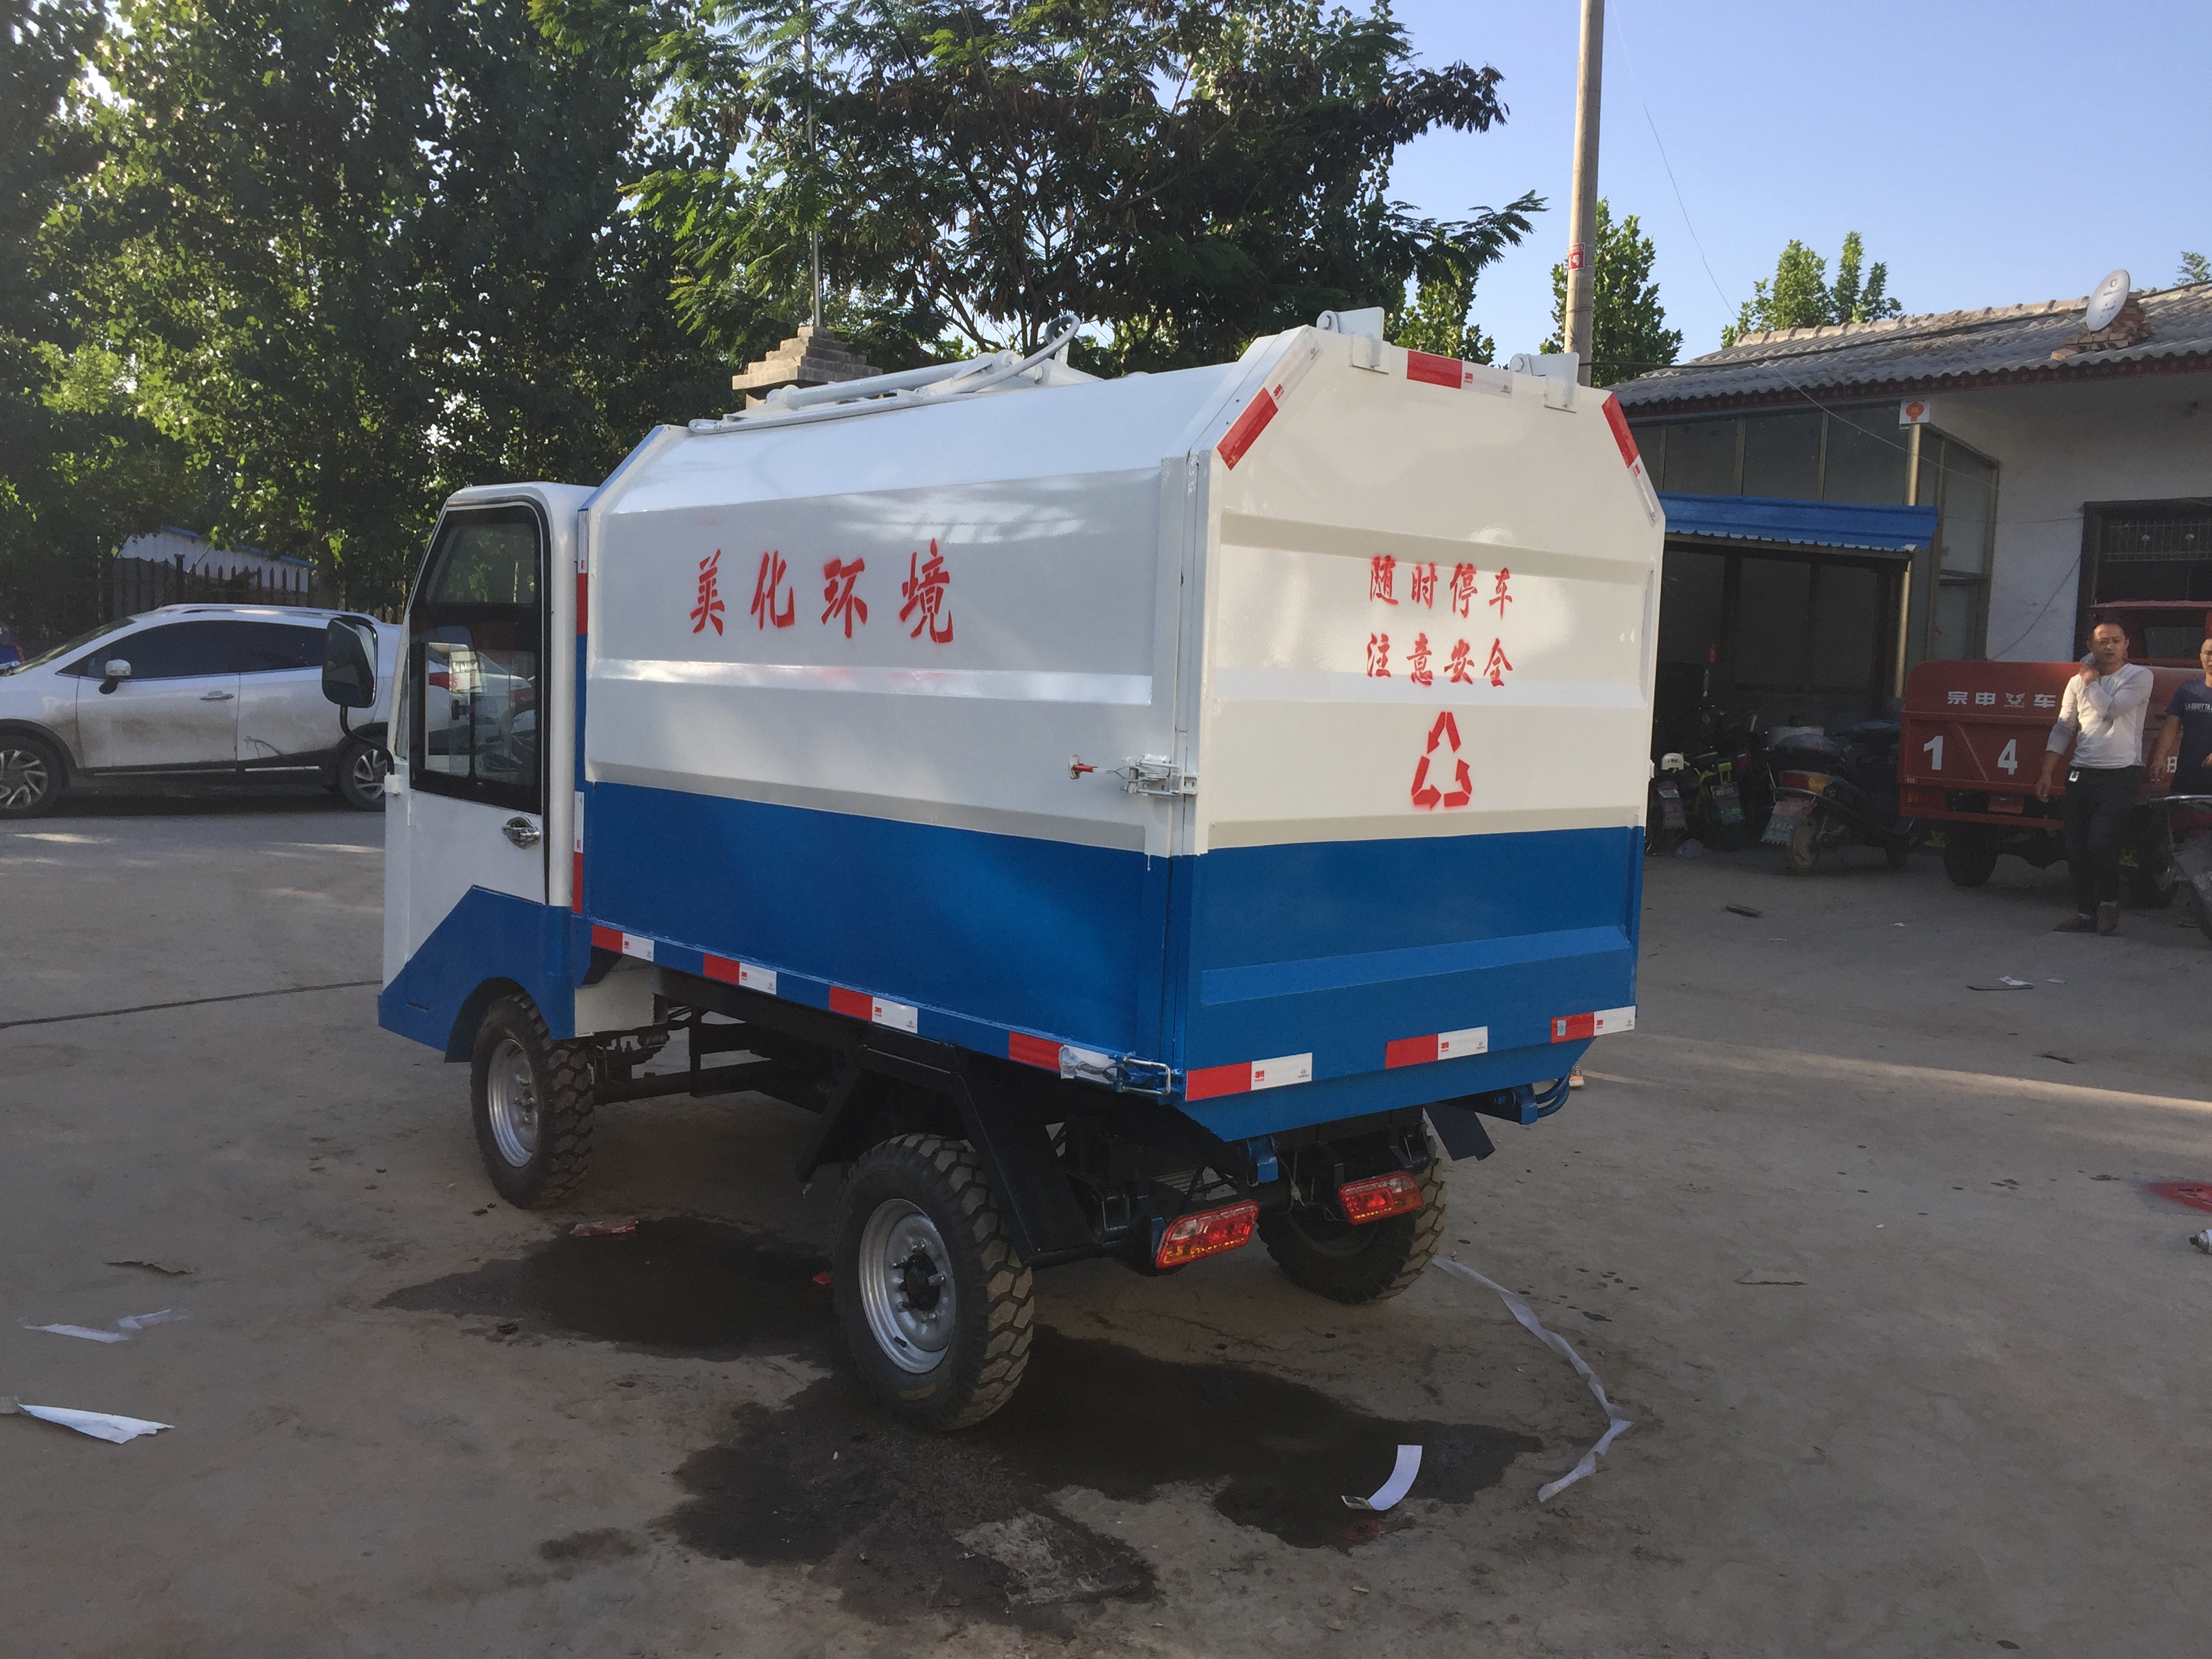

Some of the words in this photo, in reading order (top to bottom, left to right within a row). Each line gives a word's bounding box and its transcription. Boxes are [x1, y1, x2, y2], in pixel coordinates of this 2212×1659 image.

[690, 538, 954, 644] 美化环境
[1369, 554, 1513, 620] 随时停车
[1366, 632, 1513, 687] 注意安全
[2034, 694, 2056, 708] 车
[1923, 735, 1944, 771] 1
[1997, 739, 2018, 775] 4
